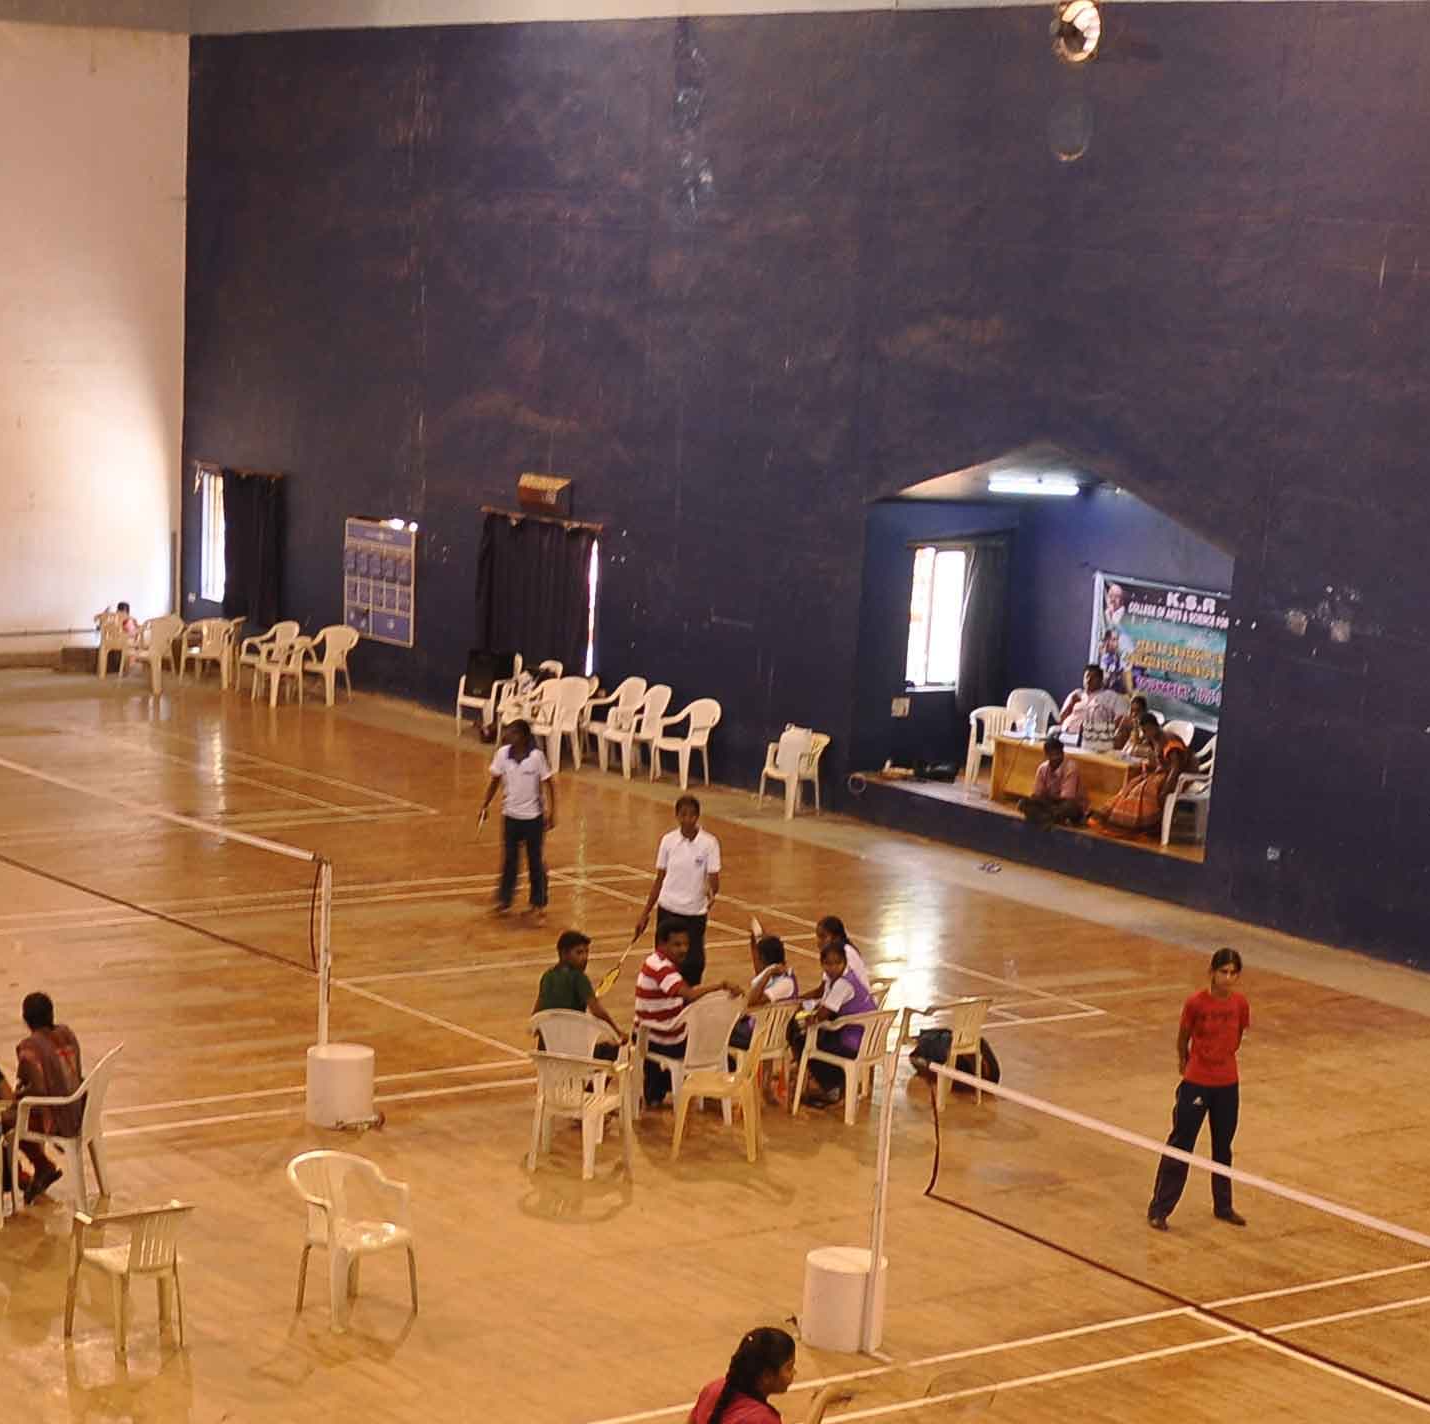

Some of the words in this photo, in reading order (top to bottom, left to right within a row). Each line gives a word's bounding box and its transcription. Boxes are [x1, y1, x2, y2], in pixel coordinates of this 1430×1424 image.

[1167, 591, 1216, 613] K.S.R
[1128, 601, 1157, 617] COLLEGE
[1156, 606, 1166, 618] OF
[1166, 607, 1183, 622] ARTS
[1189, 611, 1216, 628] SCIENCE
